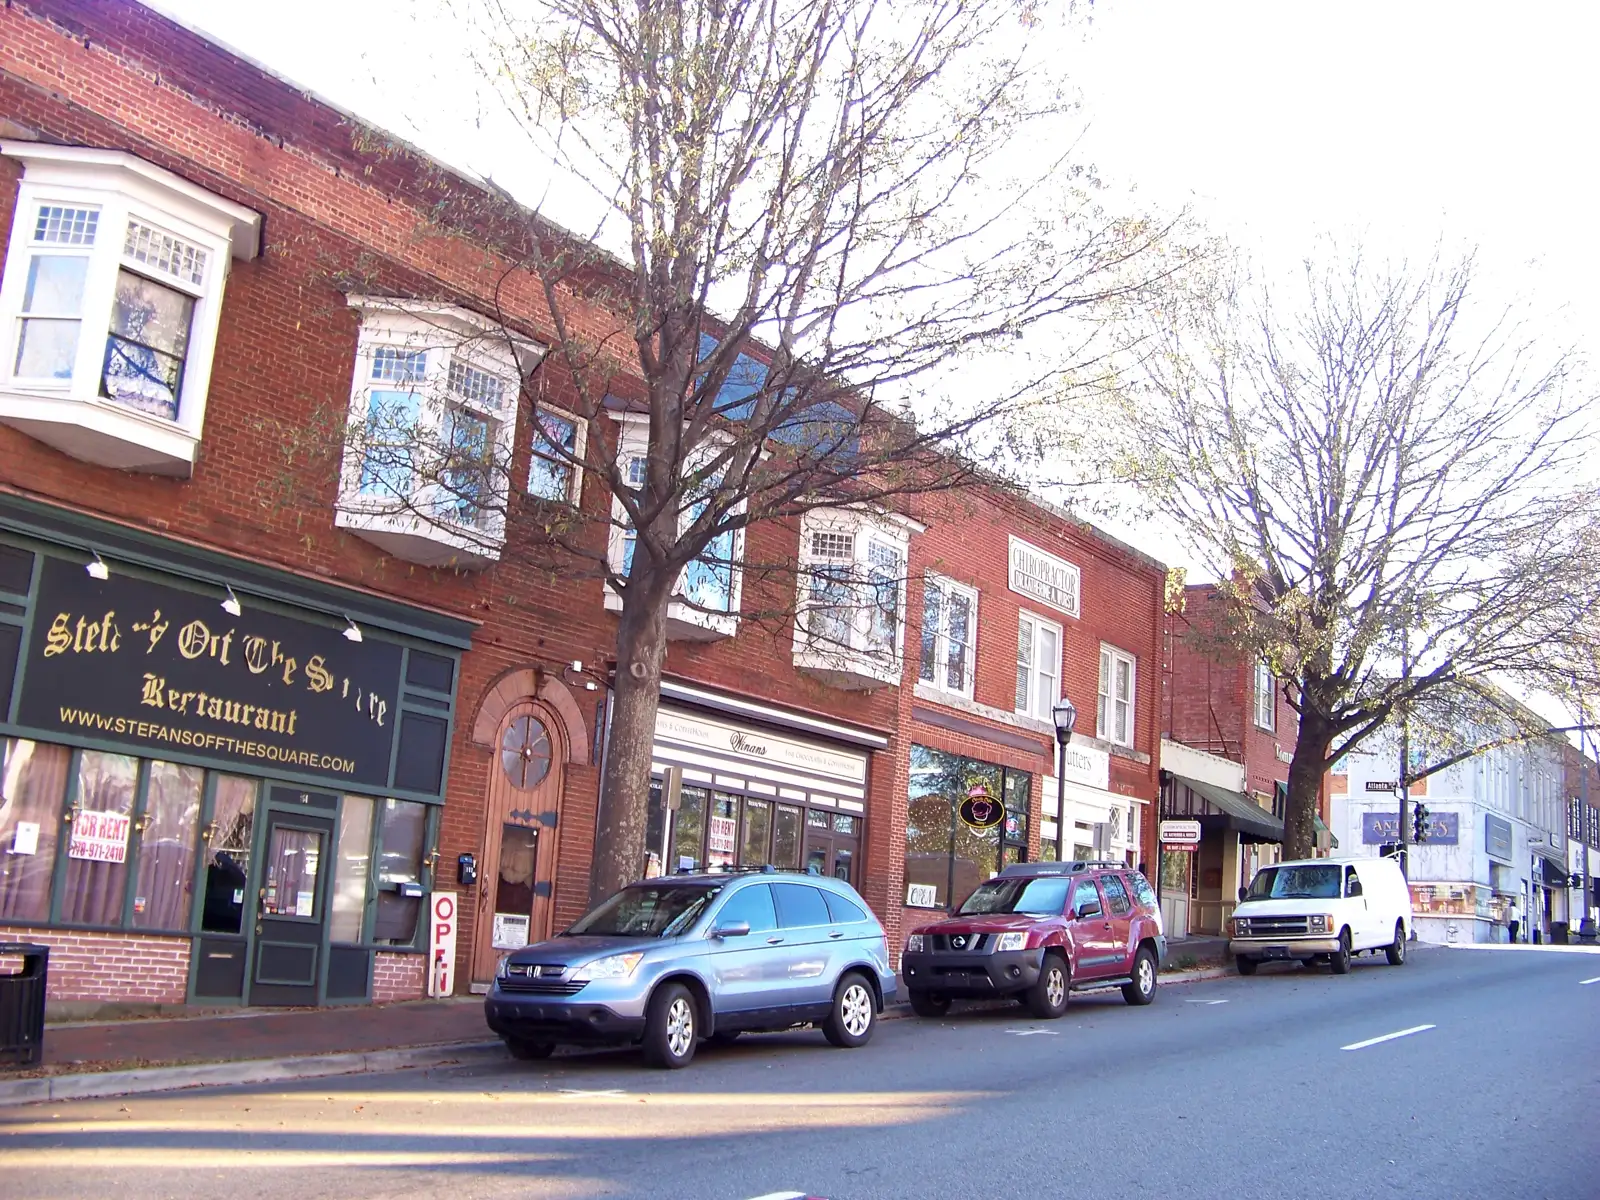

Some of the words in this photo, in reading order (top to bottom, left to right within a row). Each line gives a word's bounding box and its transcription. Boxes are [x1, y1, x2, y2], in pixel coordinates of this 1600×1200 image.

[1013, 548, 1075, 594] CHIROPRACTOR
[59, 706, 355, 774] WWW.STEFANSOFFTHESQUARE.COM
[730, 732, 767, 755] Winans
[1066, 750, 1092, 771] utters
[75, 814, 97, 837] FOR
[99, 816, 128, 841] RENT
[712, 818, 721, 835] OR
[720, 820, 734, 837] RENT
[1373, 819, 1449, 837] ANTES
